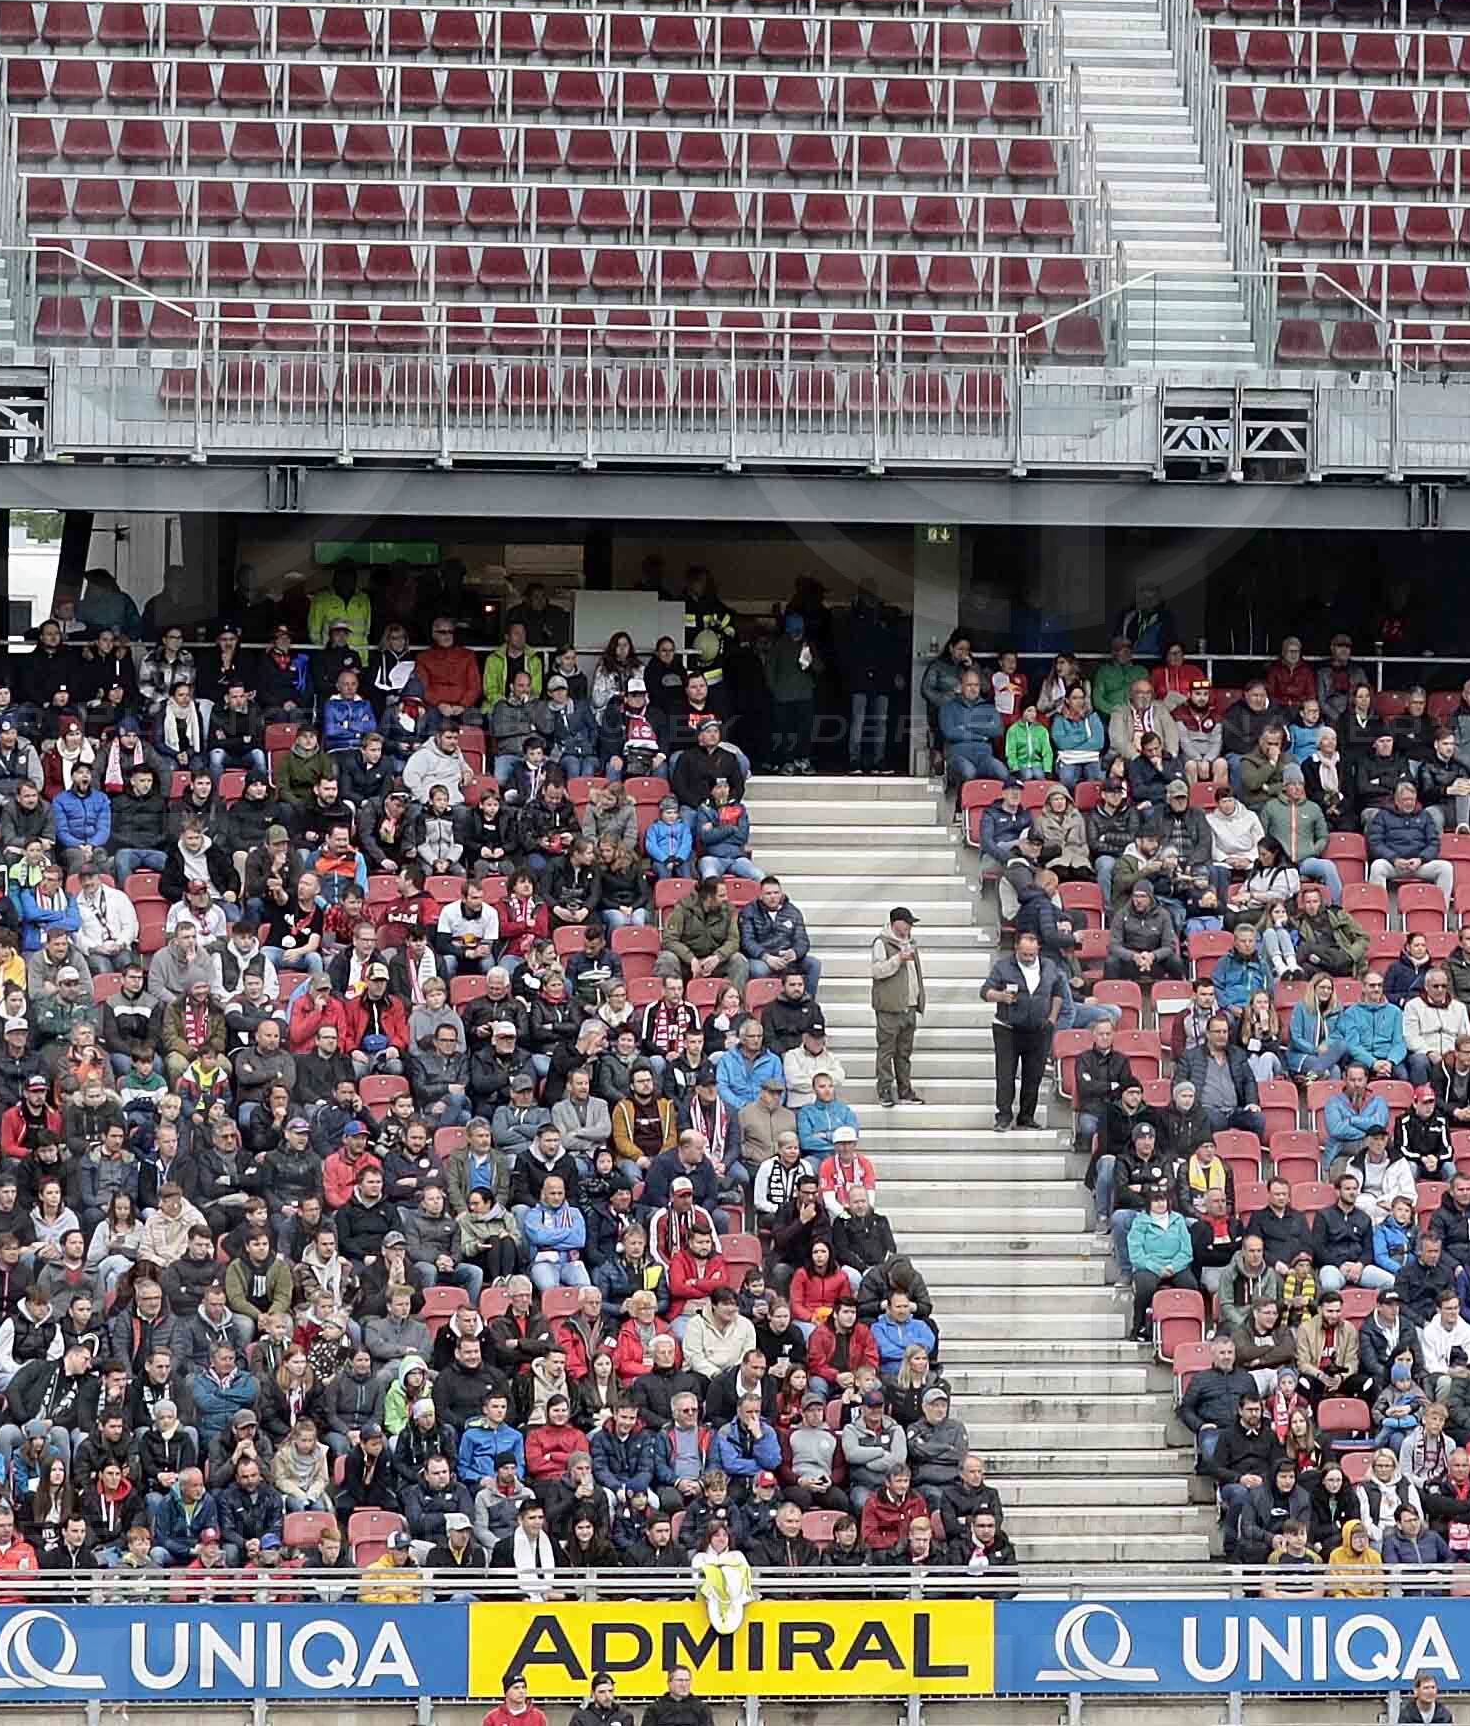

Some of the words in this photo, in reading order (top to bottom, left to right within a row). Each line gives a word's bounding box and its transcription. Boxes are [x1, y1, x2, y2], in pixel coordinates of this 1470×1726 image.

[131, 1619, 419, 1690] UNIQA
[509, 1613, 969, 1681] ADMIRAL
[1183, 1613, 1461, 1682] UNIQA
